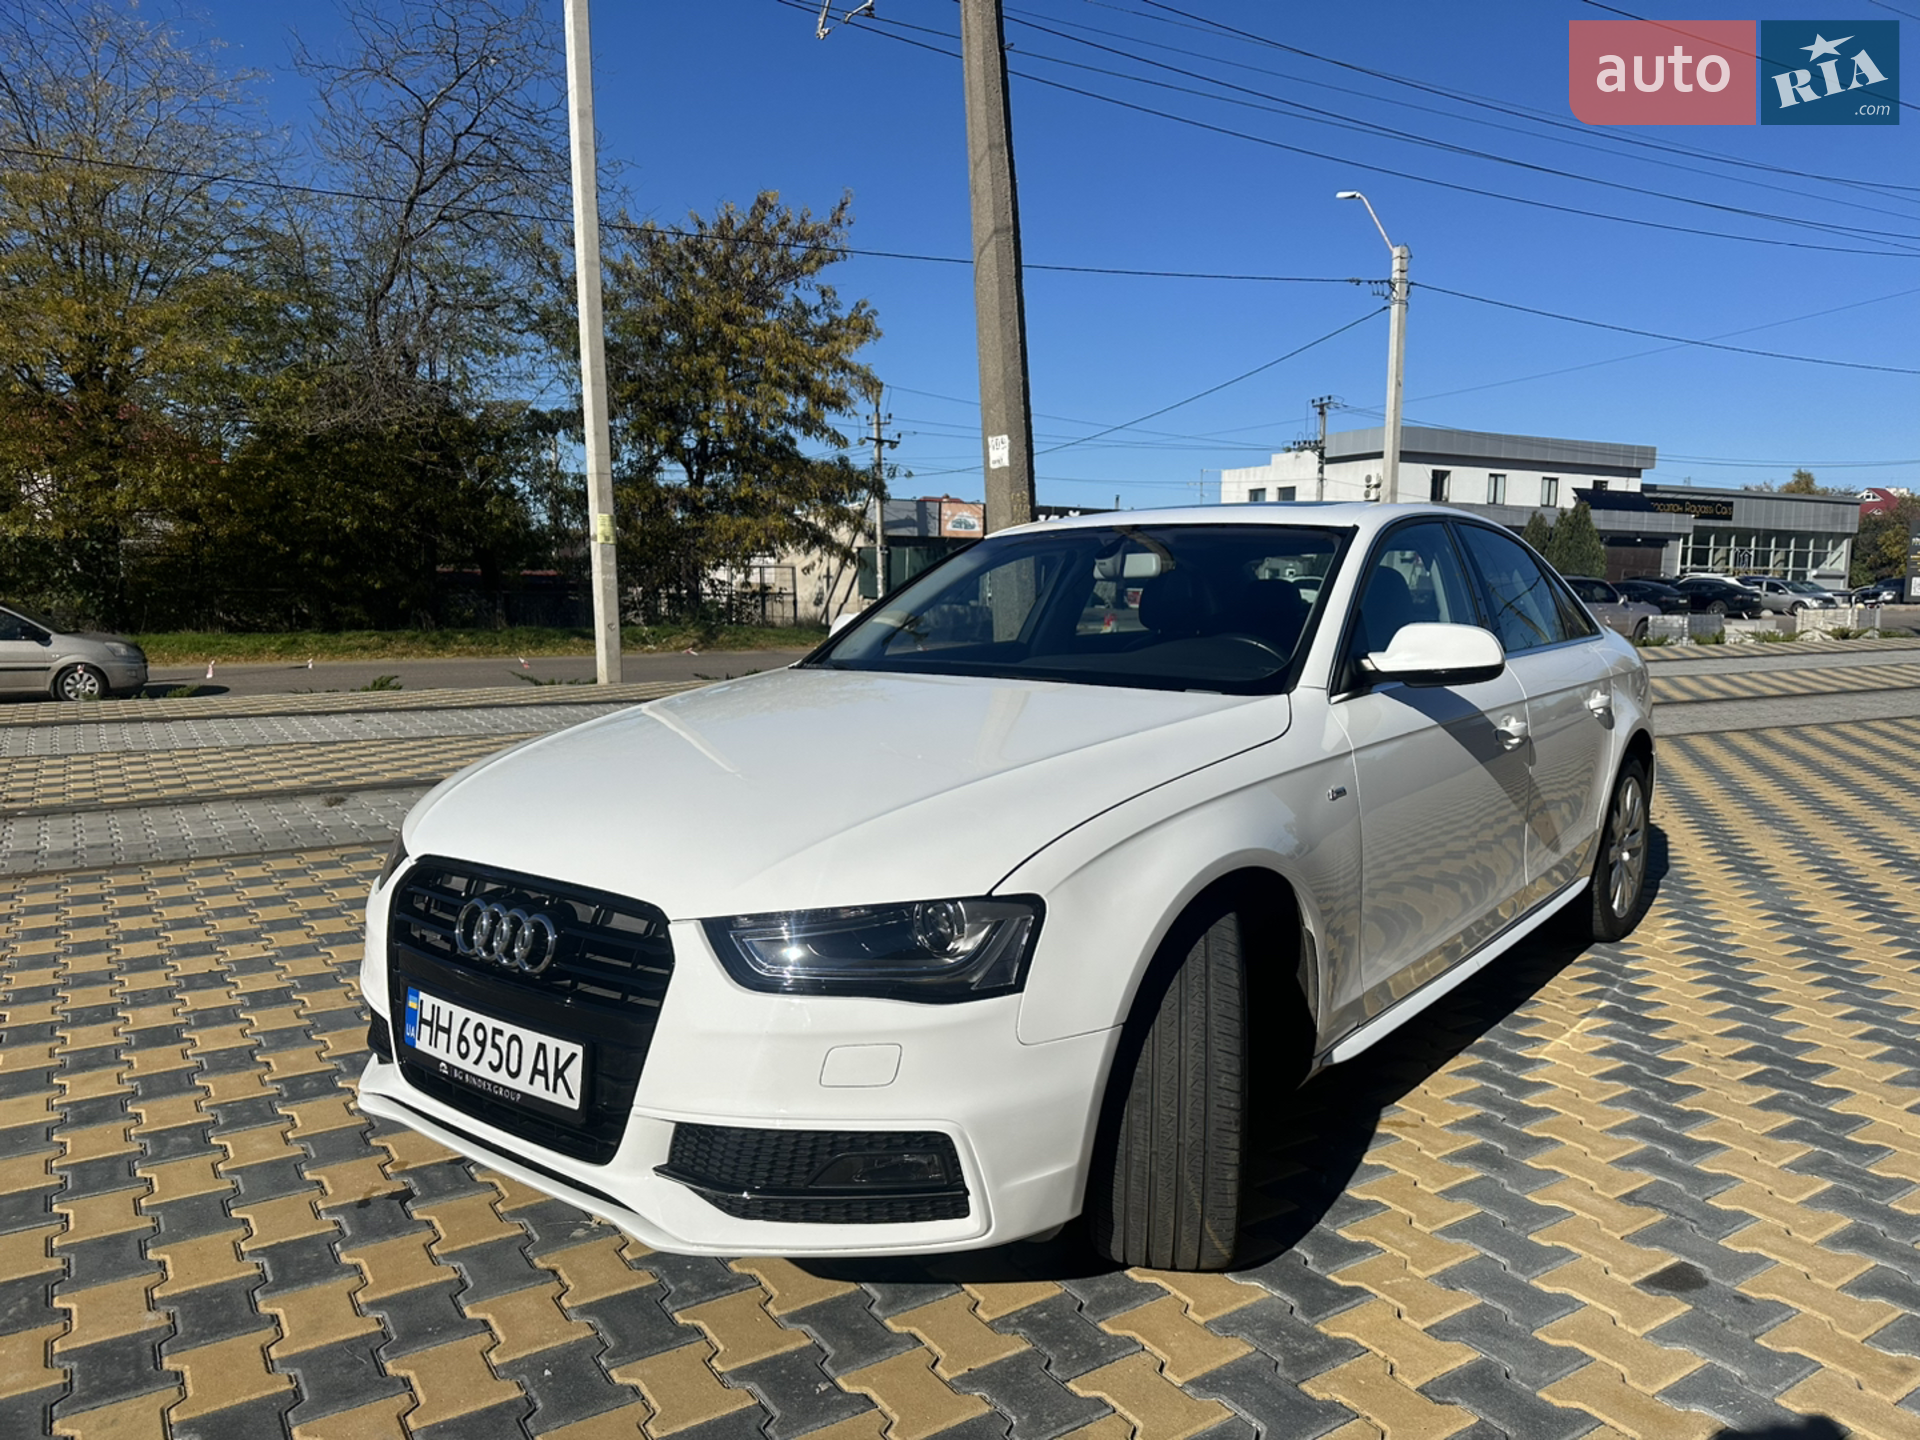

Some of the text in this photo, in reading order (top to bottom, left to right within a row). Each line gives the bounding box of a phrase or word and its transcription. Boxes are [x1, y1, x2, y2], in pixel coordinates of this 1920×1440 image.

[406, 1023, 416, 1040] UA
[417, 999, 578, 1101] HH 6950 AK
